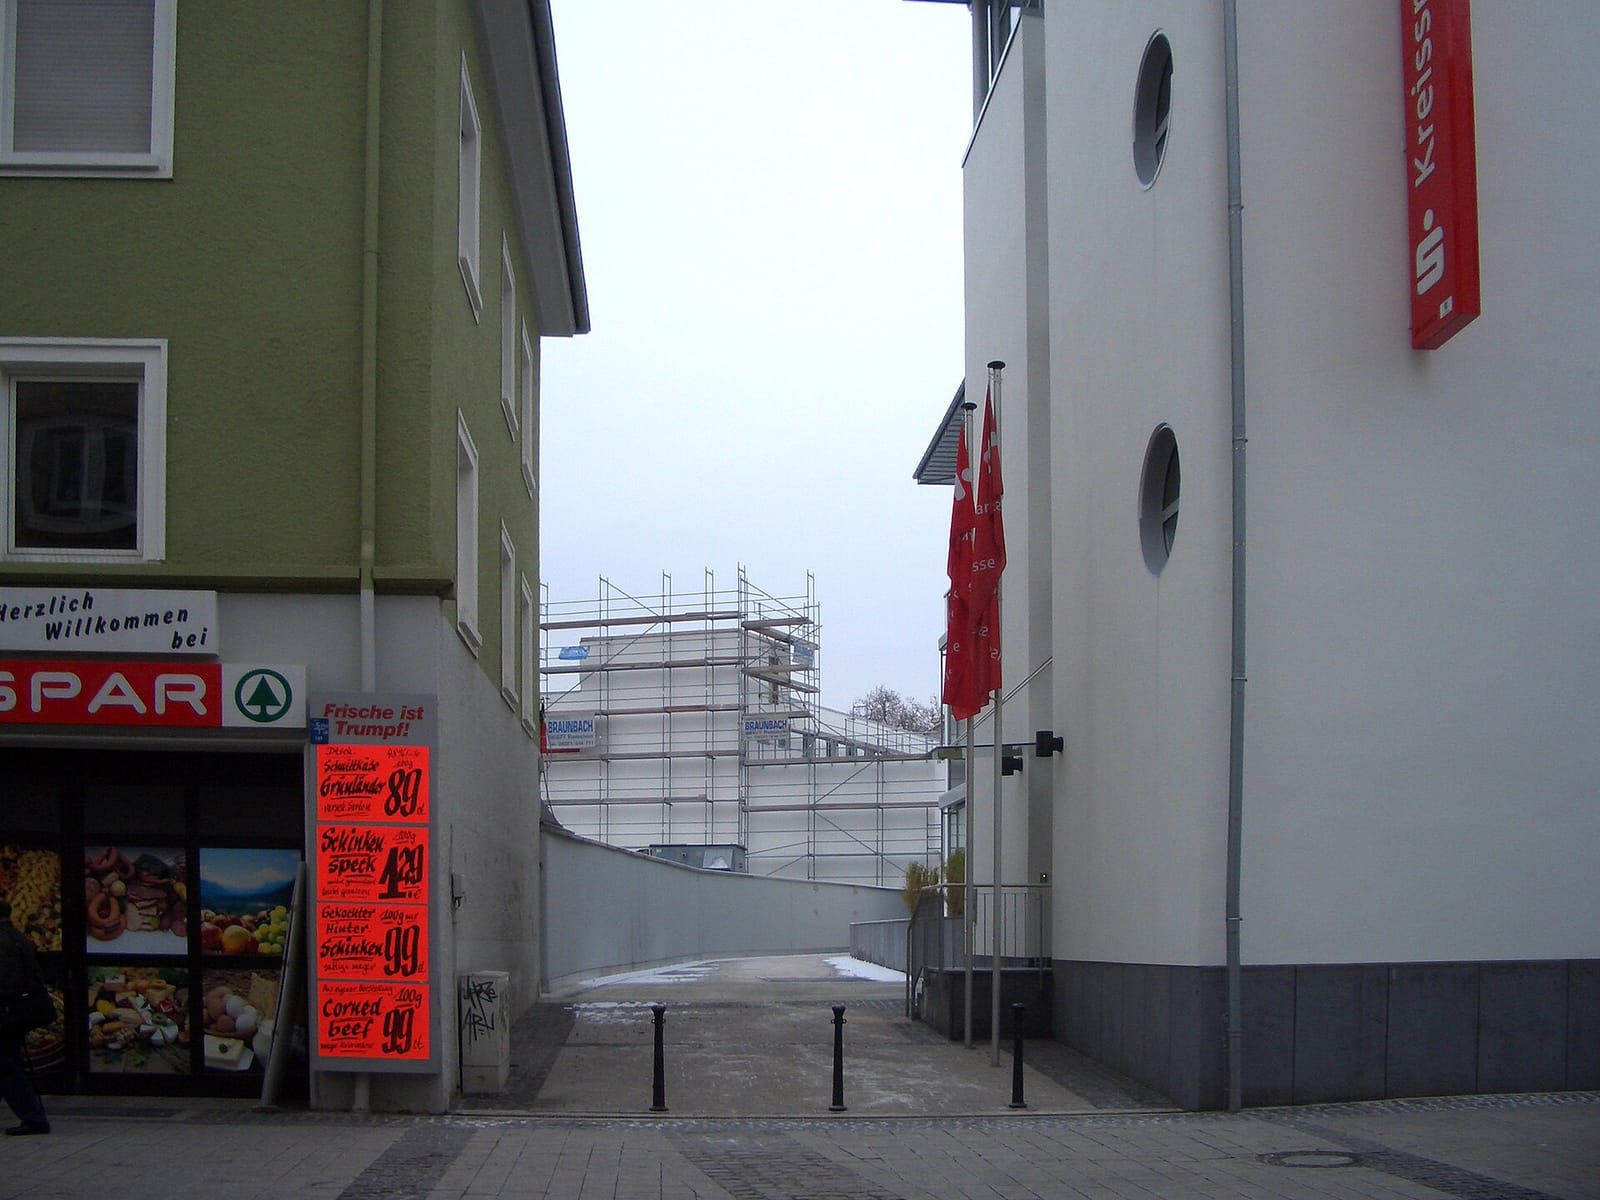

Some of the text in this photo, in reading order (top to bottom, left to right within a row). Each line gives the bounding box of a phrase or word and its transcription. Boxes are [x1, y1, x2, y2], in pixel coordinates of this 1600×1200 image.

[45, 608, 188, 640] Willkommen
[172, 628, 208, 649] bei
[324, 703, 424, 720] Frische ist
[335, 721, 410, 739] Trumpf!
[548, 719, 593, 733] BRAUNBACH
[744, 720, 787, 730] BRAUNBACH
[384, 768, 422, 817] 89
[321, 827, 384, 853] Schinken
[328, 856, 376, 877] speck
[322, 905, 376, 919] Gekochter
[320, 936, 383, 958] Schinken
[384, 925, 419, 976] 99
[323, 997, 383, 1018] Corned
[395, 987, 422, 1008] 100g
[328, 1019, 374, 1039] beef
[382, 1007, 414, 1054] 99
